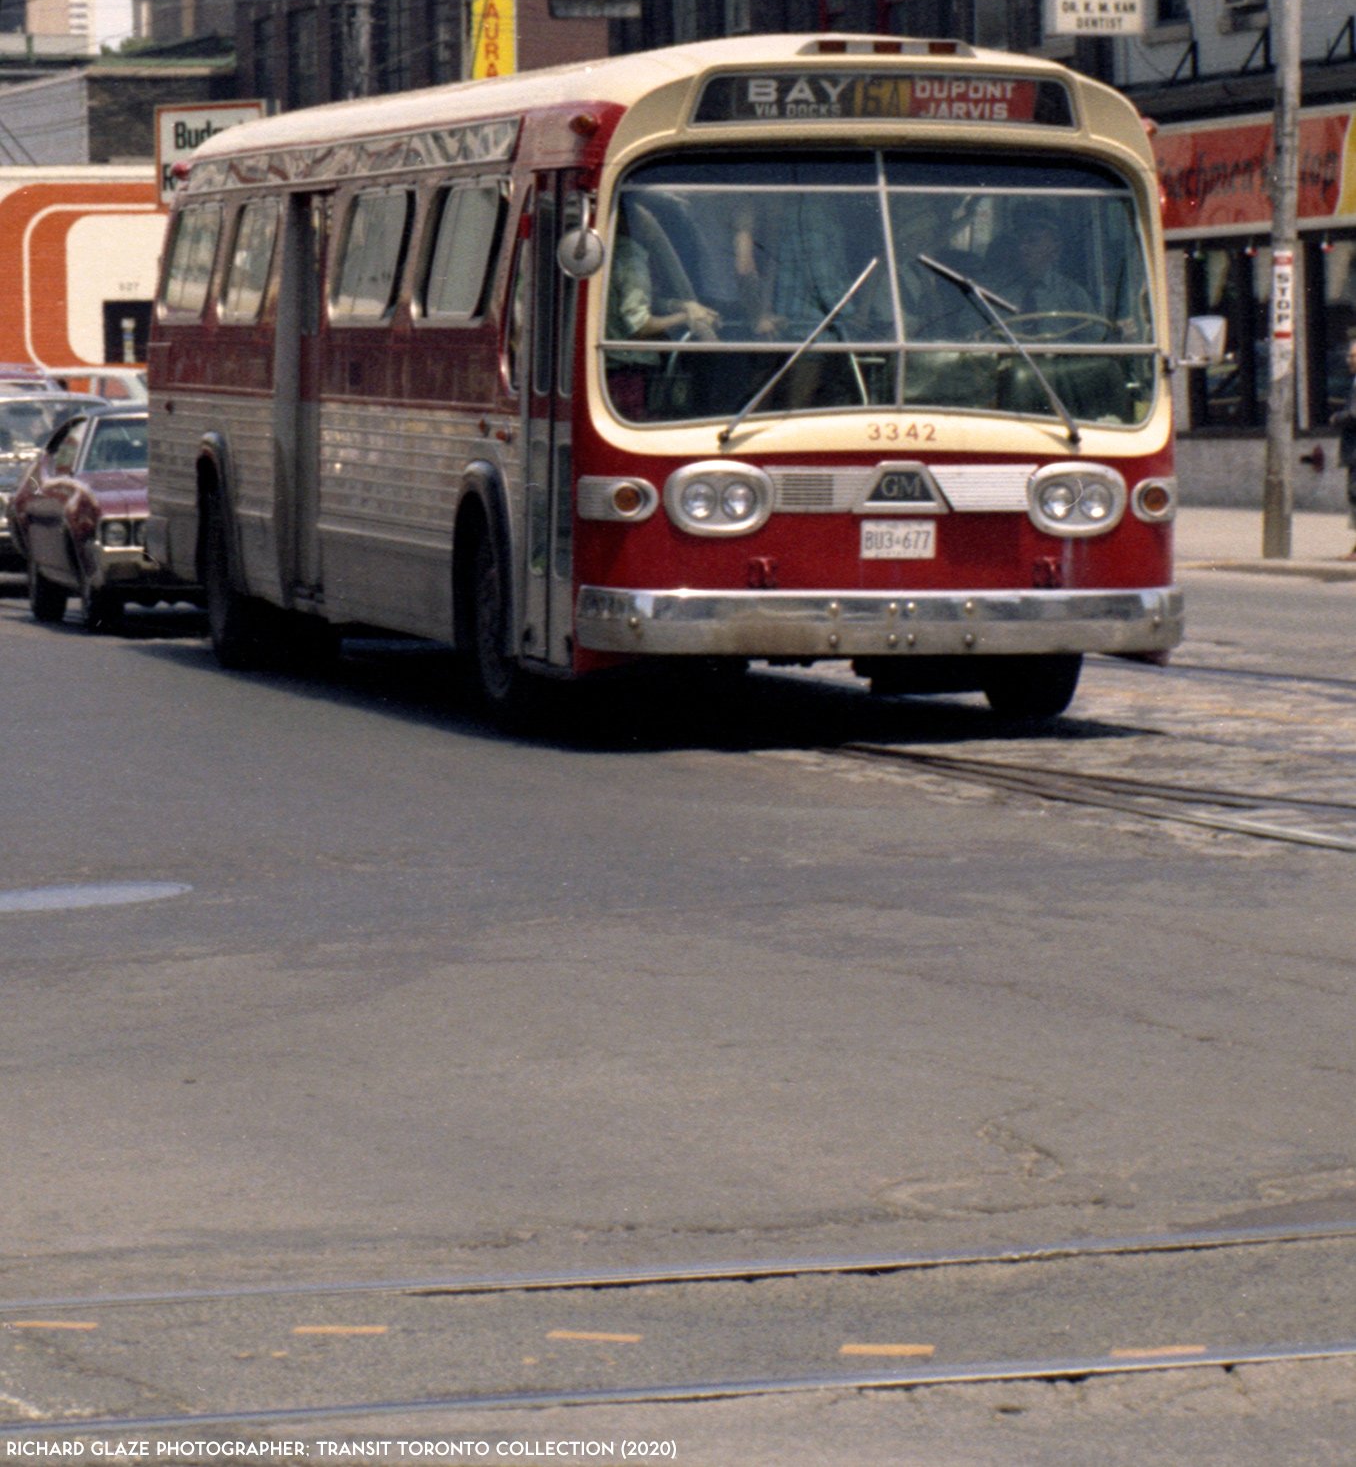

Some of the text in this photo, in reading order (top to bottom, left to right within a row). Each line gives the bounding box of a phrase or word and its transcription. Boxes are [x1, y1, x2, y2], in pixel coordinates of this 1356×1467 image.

[1076, 17, 1122, 30] DENTIST
[748, 78, 850, 102] BAY
[915, 79, 1016, 100] DUPONT
[755, 104, 841, 118] VIA DOCKS
[920, 101, 1008, 119] JARVIS
[1276, 273, 1290, 325] STOP
[867, 422, 937, 441] 3342
[881, 475, 920, 498] GM
